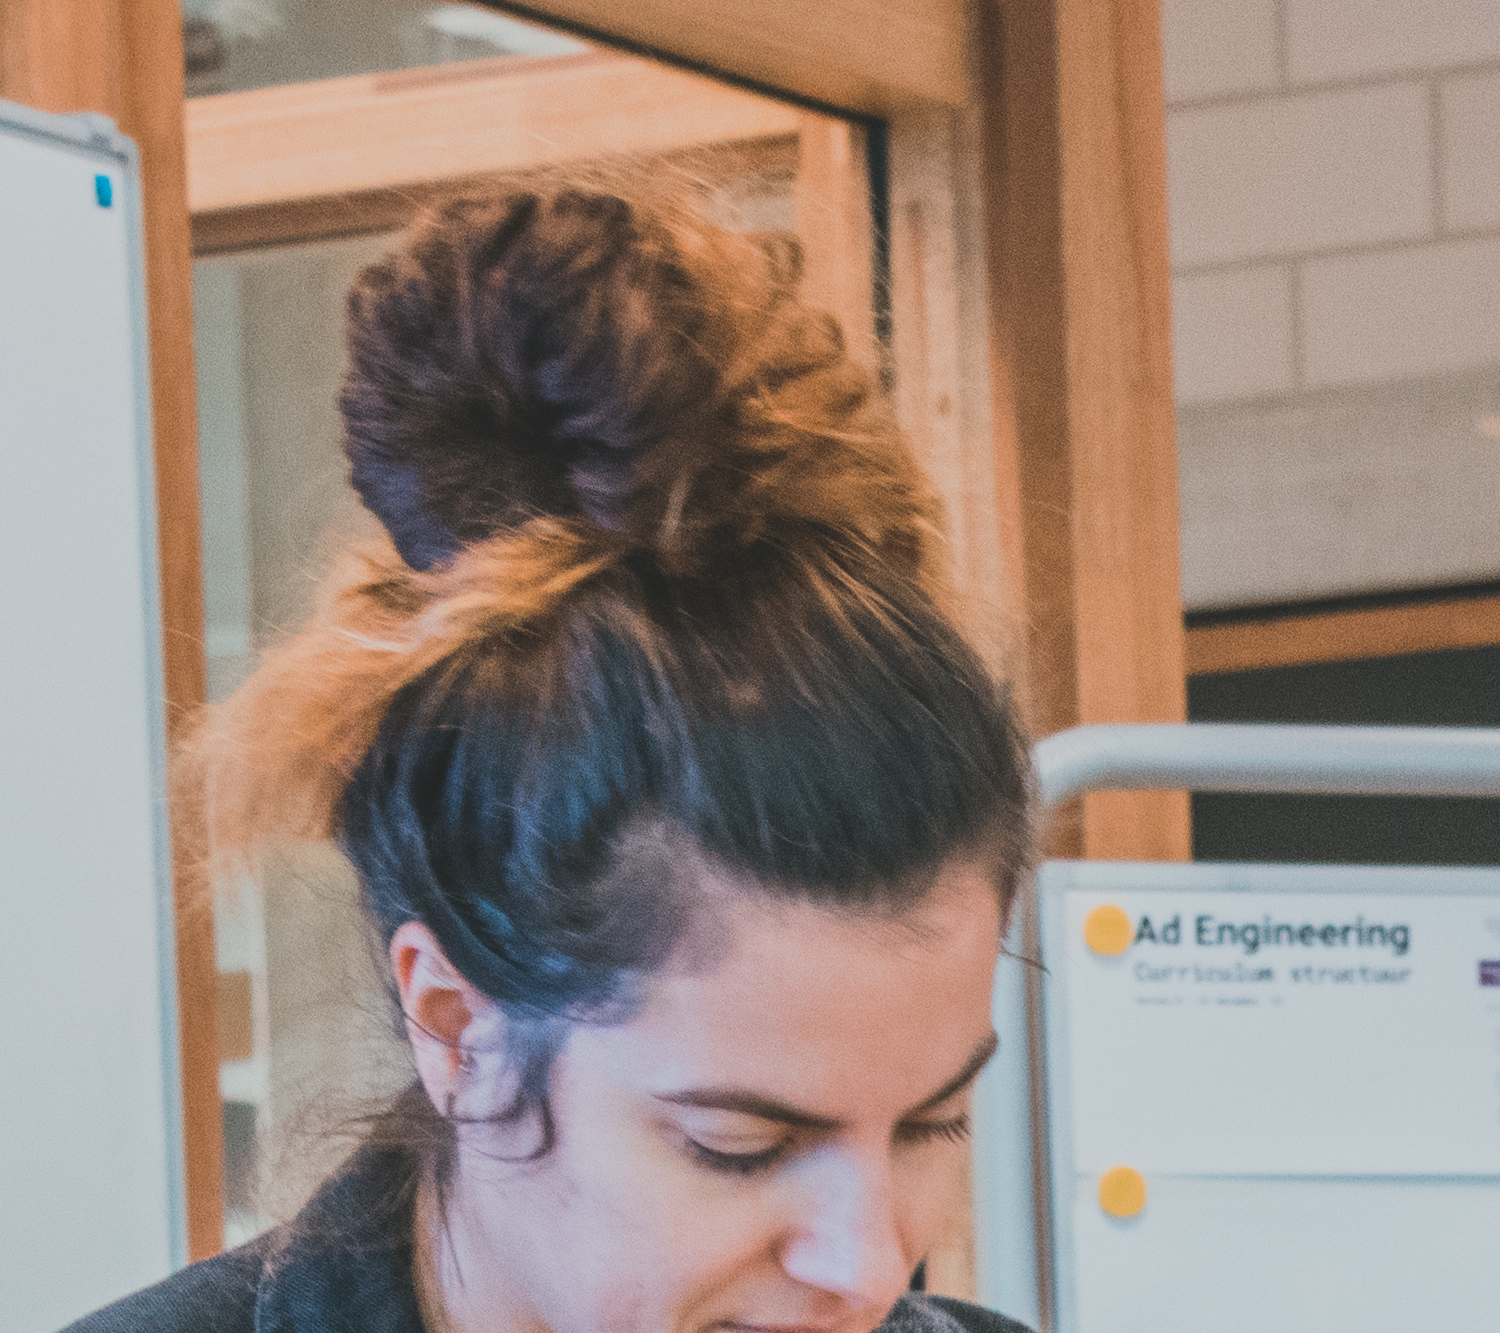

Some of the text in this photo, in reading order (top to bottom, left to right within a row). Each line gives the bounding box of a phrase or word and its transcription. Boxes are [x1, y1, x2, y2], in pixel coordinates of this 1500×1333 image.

[1135, 914, 1410, 955] Ad Engineering
[1134, 962, 1275, 983] Curriculum
